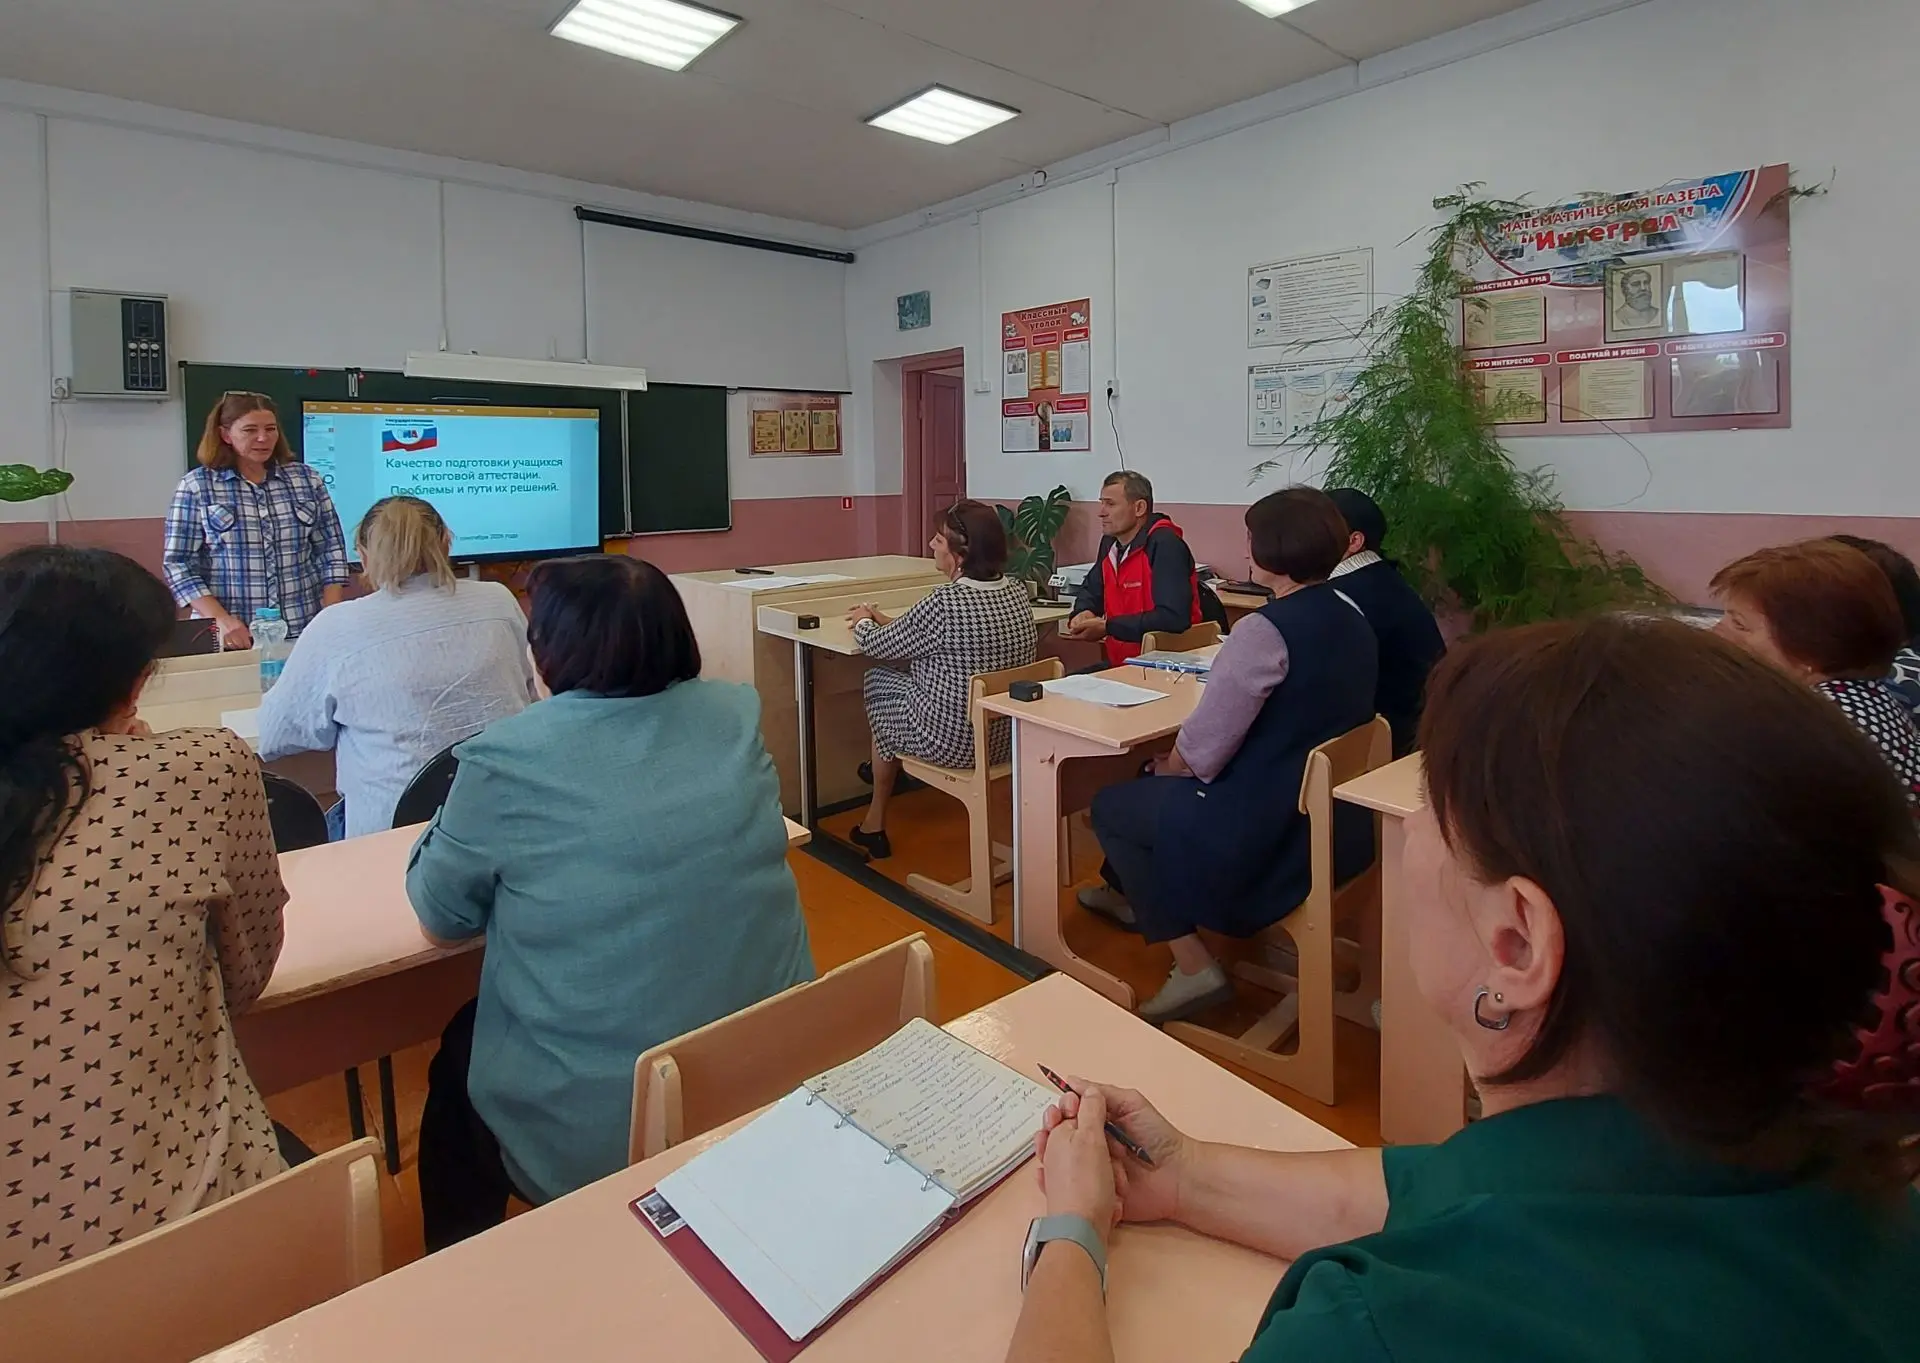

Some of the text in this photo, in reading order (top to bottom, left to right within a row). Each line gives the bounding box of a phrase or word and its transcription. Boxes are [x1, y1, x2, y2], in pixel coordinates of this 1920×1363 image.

[1499, 183, 1723, 233] МАТЕМАТИЧЕСКАЯ ГАЗЕТА
[1513, 278, 1529, 286] ДЛЯ
[1530, 276, 1547, 284] УМА
[1021, 306, 1067, 321] Классный
[1030, 319, 1062, 331] уголок
[1569, 349, 1611, 360] ПОДУМАЙ
[1620, 347, 1646, 356] РЕШИ
[1491, 357, 1535, 367] ИНТЕРЕСНО
[386, 458, 563, 469] Качество подготовки учащихся
[412, 471, 541, 481] к итоговой аттестации.
[390, 485, 454, 496] Проблемы
[467, 485, 492, 496] пути
[495, 485, 508, 493] их
[510, 482, 559, 494] решений.
